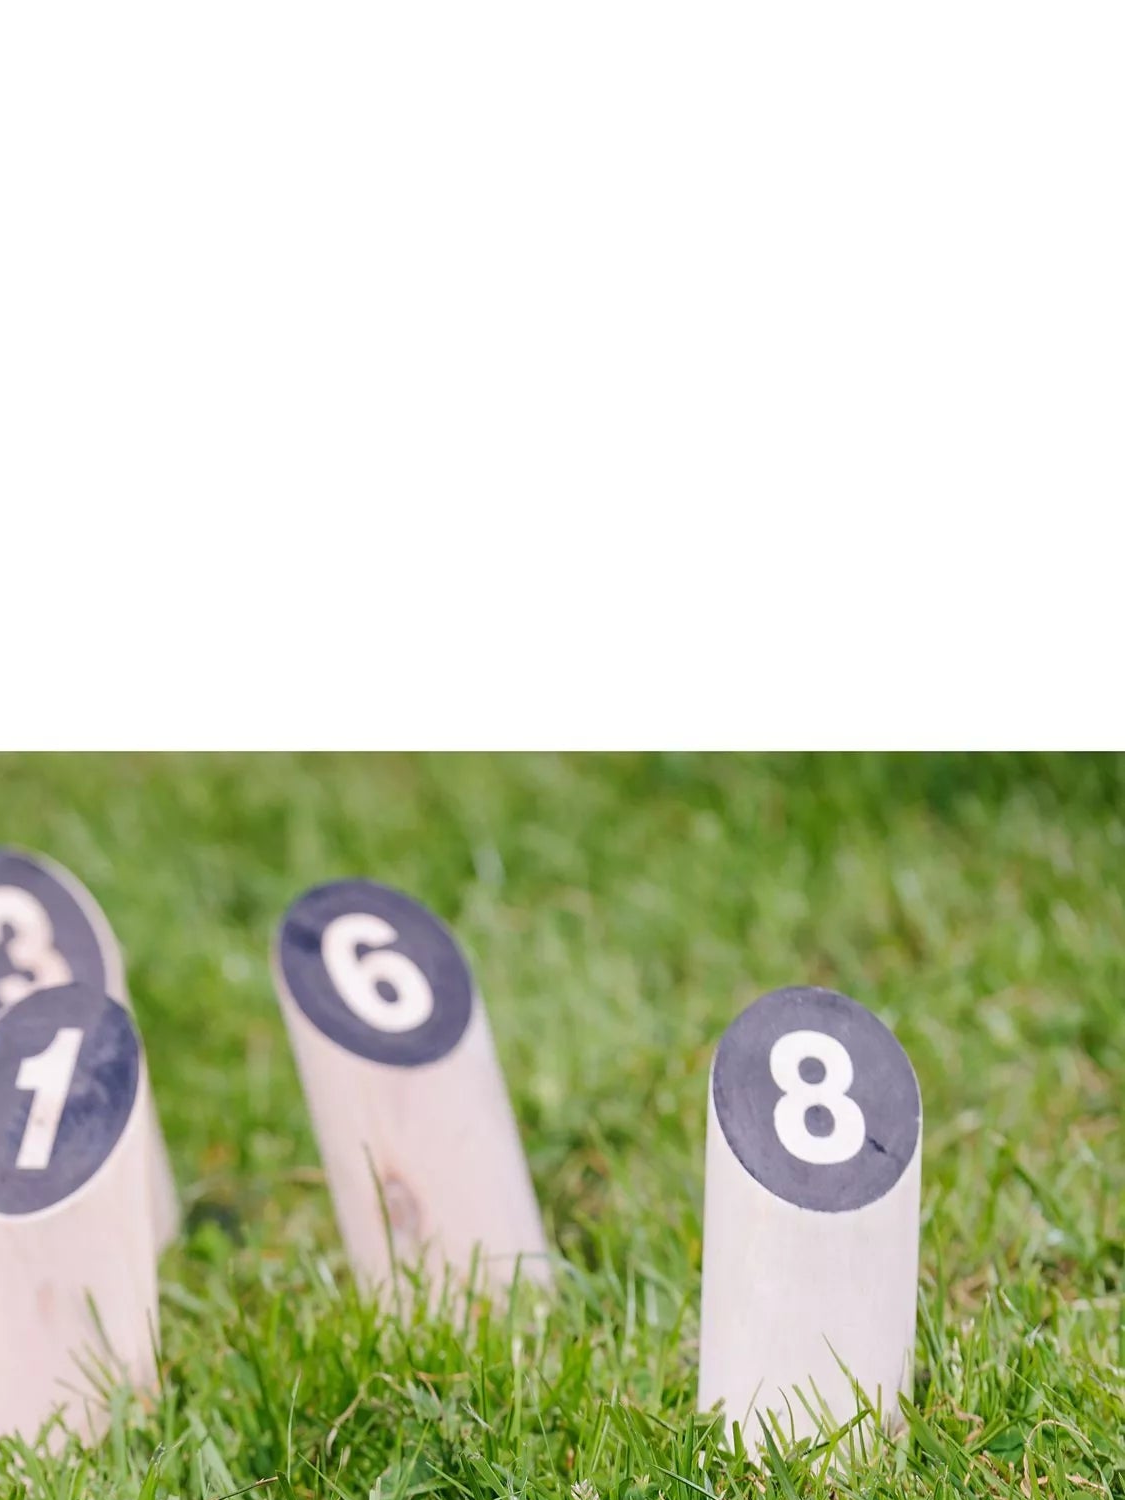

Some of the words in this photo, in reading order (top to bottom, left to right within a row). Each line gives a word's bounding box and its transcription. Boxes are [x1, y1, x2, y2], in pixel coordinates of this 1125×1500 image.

[322, 913, 433, 1033] 6
[15, 1027, 84, 1170] 1
[769, 1030, 866, 1165] 8
